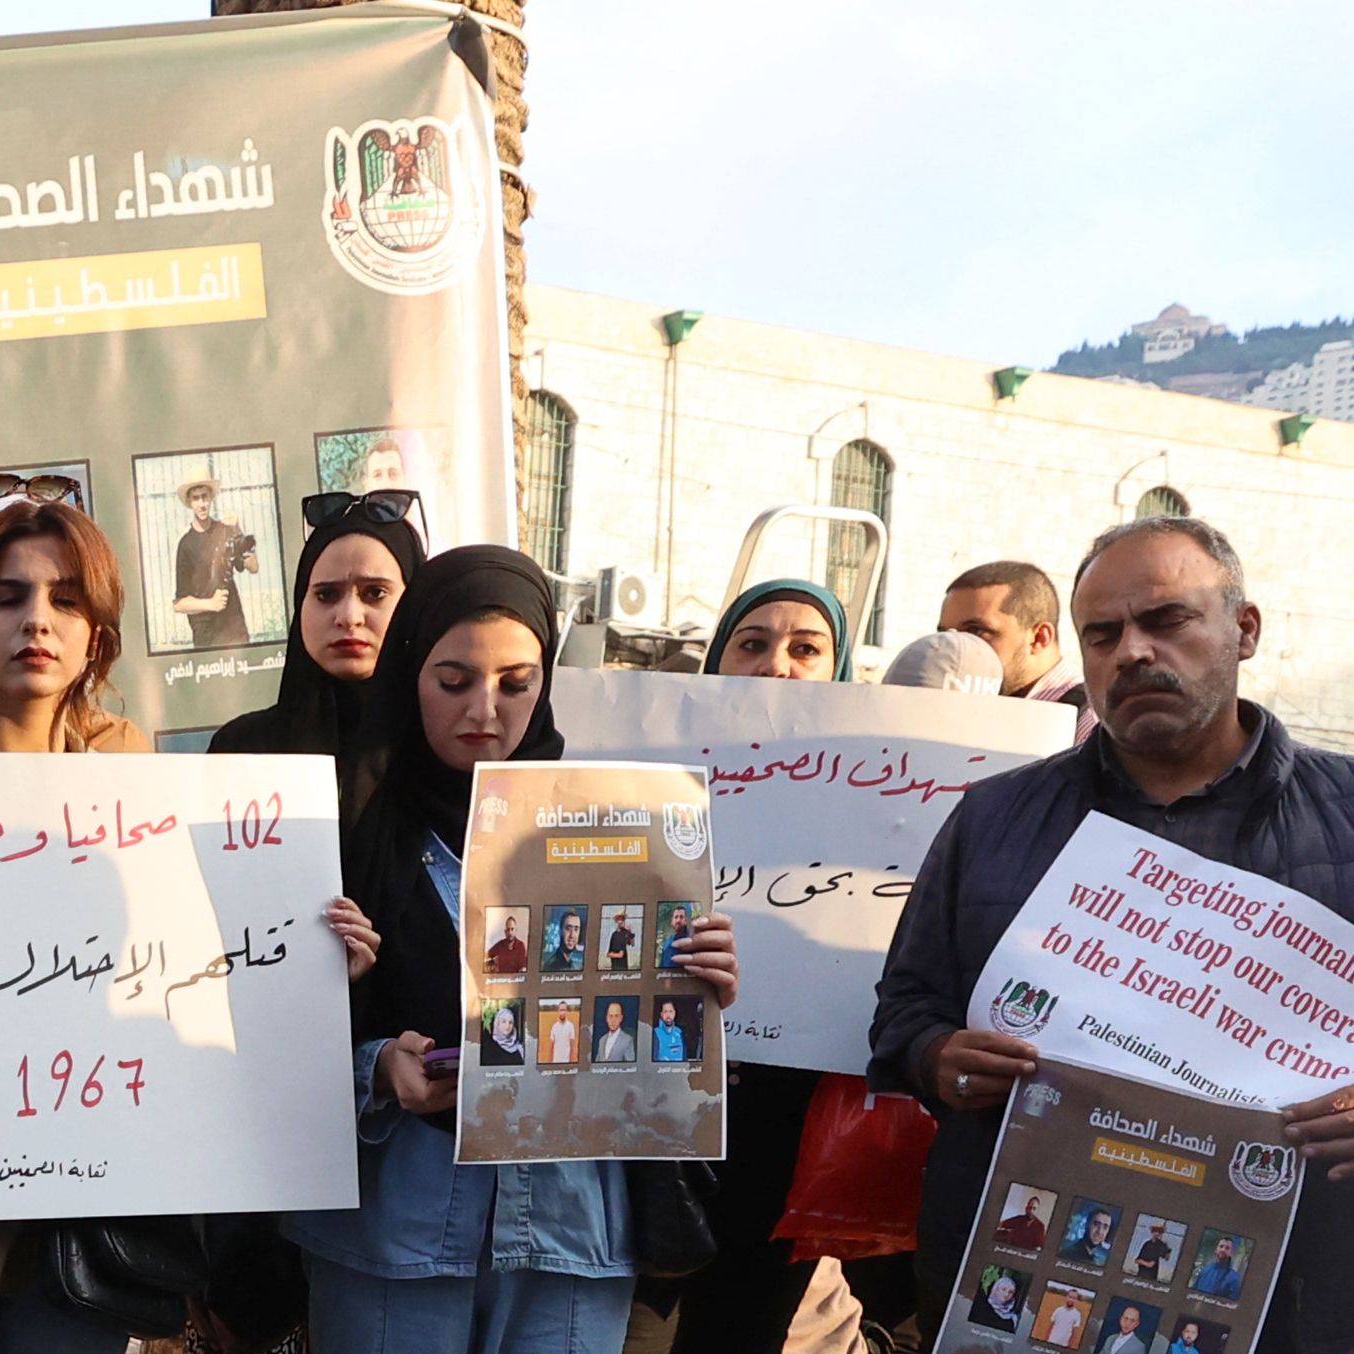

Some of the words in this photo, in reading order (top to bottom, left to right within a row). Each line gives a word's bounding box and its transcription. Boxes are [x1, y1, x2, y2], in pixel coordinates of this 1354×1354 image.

[114, 137, 275, 220] شهداء
[943, 672, 999, 695] NIK
[221, 791, 284, 851] 102
[478, 796, 509, 817] PRESS
[535, 803, 599, 828] الصحافة
[602, 803, 652, 827] شهداء
[62, 799, 177, 865] صحافيا
[551, 840, 641, 860] الفلسطينية
[767, 861, 854, 907] بحق
[1125, 847, 1268, 931] Targeting
[1068, 883, 1126, 922] will
[1118, 906, 1172, 943] not
[1168, 927, 1232, 973] stop
[1234, 955, 1283, 996] our
[164, 918, 295, 1021] قتلهم
[1041, 921, 1072, 955] to
[1073, 936, 1120, 977] the
[1120, 956, 1221, 1020] Israeli
[1215, 1003, 1268, 1049] war
[1265, 1038, 1350, 1080] crime
[745, 1019, 782, 1041] نقابة
[1077, 1014, 1172, 1069] Palestinian
[16, 1049, 147, 1119] 1967
[1023, 1082, 1062, 1106] PRESS
[1089, 1107, 1157, 1140] الصحافة
[1160, 1124, 1217, 1157] شهداء
[67, 1158, 108, 1183] نقابة
[1098, 1143, 1197, 1179] الفلسطينية
